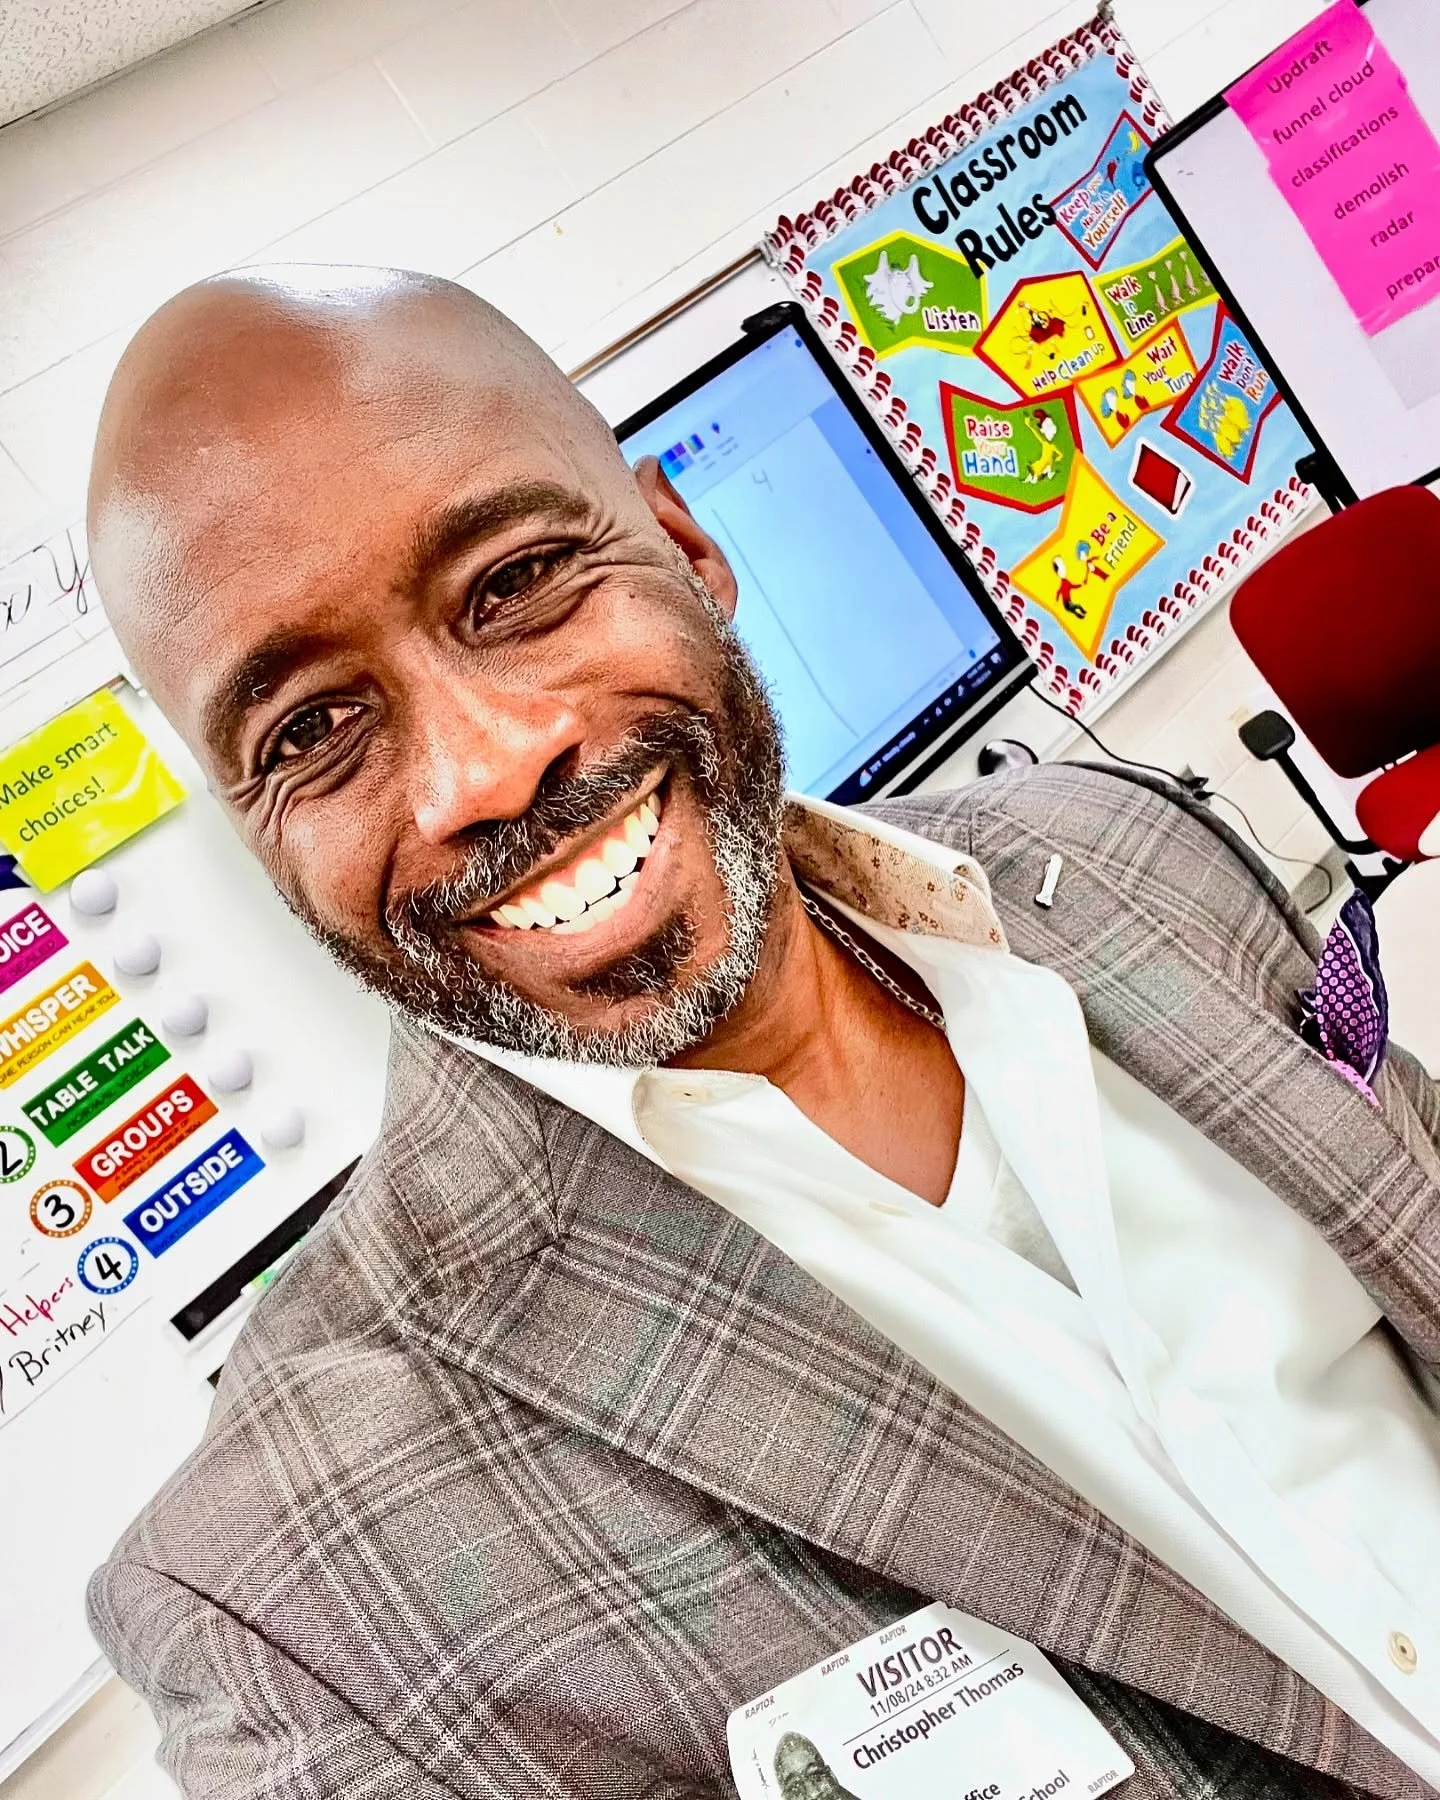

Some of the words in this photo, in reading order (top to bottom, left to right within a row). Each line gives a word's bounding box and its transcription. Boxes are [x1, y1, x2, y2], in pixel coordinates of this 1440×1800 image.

[1266, 40, 1333, 94] Updraft
[1272, 96, 1327, 144] funnel
[1329, 61, 1375, 103] cloud
[912, 94, 1087, 234] Classroom
[1291, 106, 1399, 187] classifications
[1060, 191, 1089, 223] Keep
[1334, 162, 1409, 219] demolish
[955, 193, 1056, 279] Rules
[1084, 191, 1127, 247] Yourself
[1370, 211, 1414, 247] radar
[1107, 277, 1141, 302] Walk
[1386, 255, 1440, 300] prepar
[924, 309, 980, 331] Listen
[1124, 300, 1137, 314] in
[1126, 312, 1155, 335] Line
[1146, 336, 1177, 364] Wait
[1219, 341, 1245, 381] Walk
[1032, 370, 1057, 391] Help
[1058, 350, 1093, 380] Clean
[1143, 365, 1167, 385] Your
[1165, 372, 1193, 393] Turn
[1246, 371, 1269, 401] Run
[967, 418, 1009, 437] Raise
[965, 449, 1016, 473] Hand
[1090, 521, 1111, 547] Be
[1107, 511, 1117, 522] a
[1103, 514, 1138, 570] Friend
[0, 765, 54, 811] Make
[55, 722, 118, 769] smart
[19, 775, 105, 842] choices!
[51, 1022, 73, 1042] CAN
[29, 1070, 99, 1126] TABLE
[97, 1026, 154, 1072] TALK
[91, 1089, 194, 1177] GROUPS
[140, 1142, 244, 1233] OUTSIDE
[44, 1194, 75, 1228] 3
[95, 1253, 123, 1280] 4
[0, 1277, 73, 1336] Helpers
[9, 1302, 106, 1386] Britney
[879, 1624, 907, 1646] RAPTOR
[820, 1654, 850, 1677] RAPTOR
[856, 1627, 963, 1698] VISITOR
[870, 1680, 925, 1717] 11/08/24
[924, 1666, 951, 1690] 8:32
[952, 1653, 973, 1674] AM
[745, 1695, 775, 1719] RAPTOR
[853, 1700, 957, 1769] Christopher
[953, 1661, 1024, 1708] Thomas
[1088, 1769, 1119, 1793] RAPTOR
